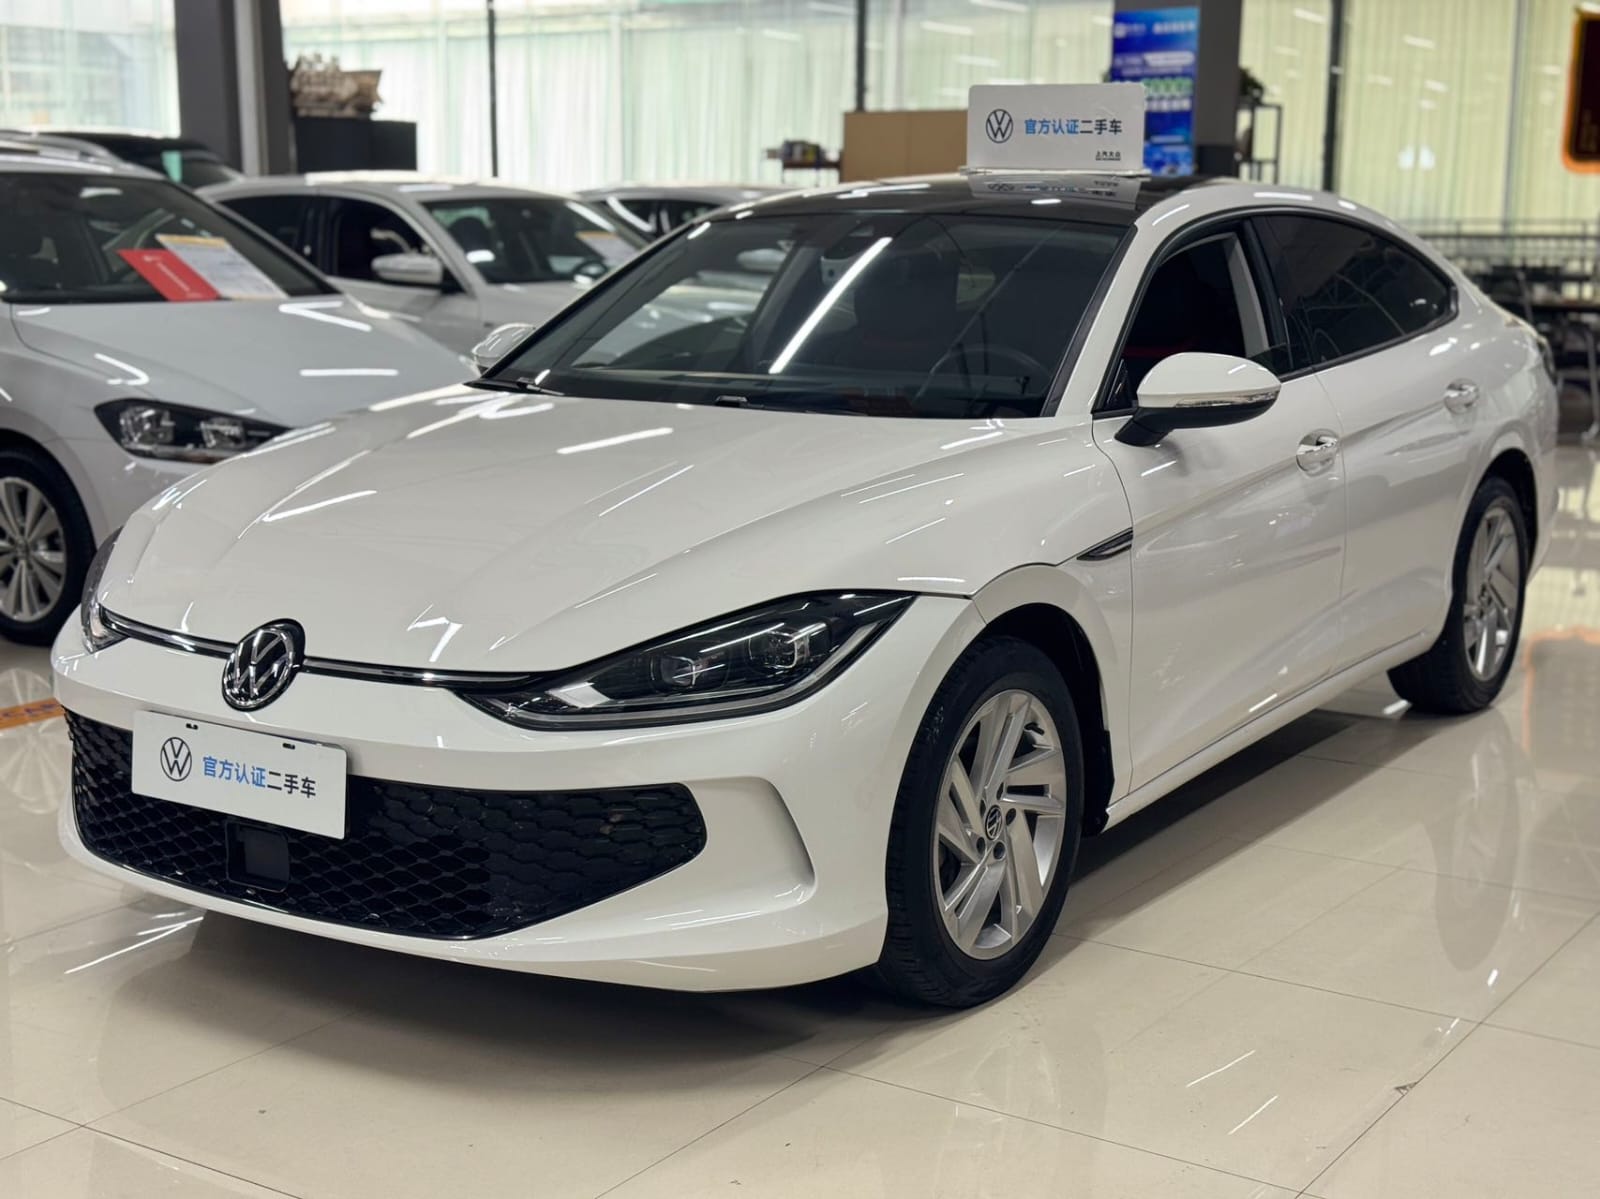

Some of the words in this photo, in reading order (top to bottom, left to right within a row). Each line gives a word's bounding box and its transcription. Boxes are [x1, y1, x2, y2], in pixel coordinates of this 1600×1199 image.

[1023, 118, 1123, 136] 官方认证二手车
[202, 755, 317, 799] 官方认证二手车
